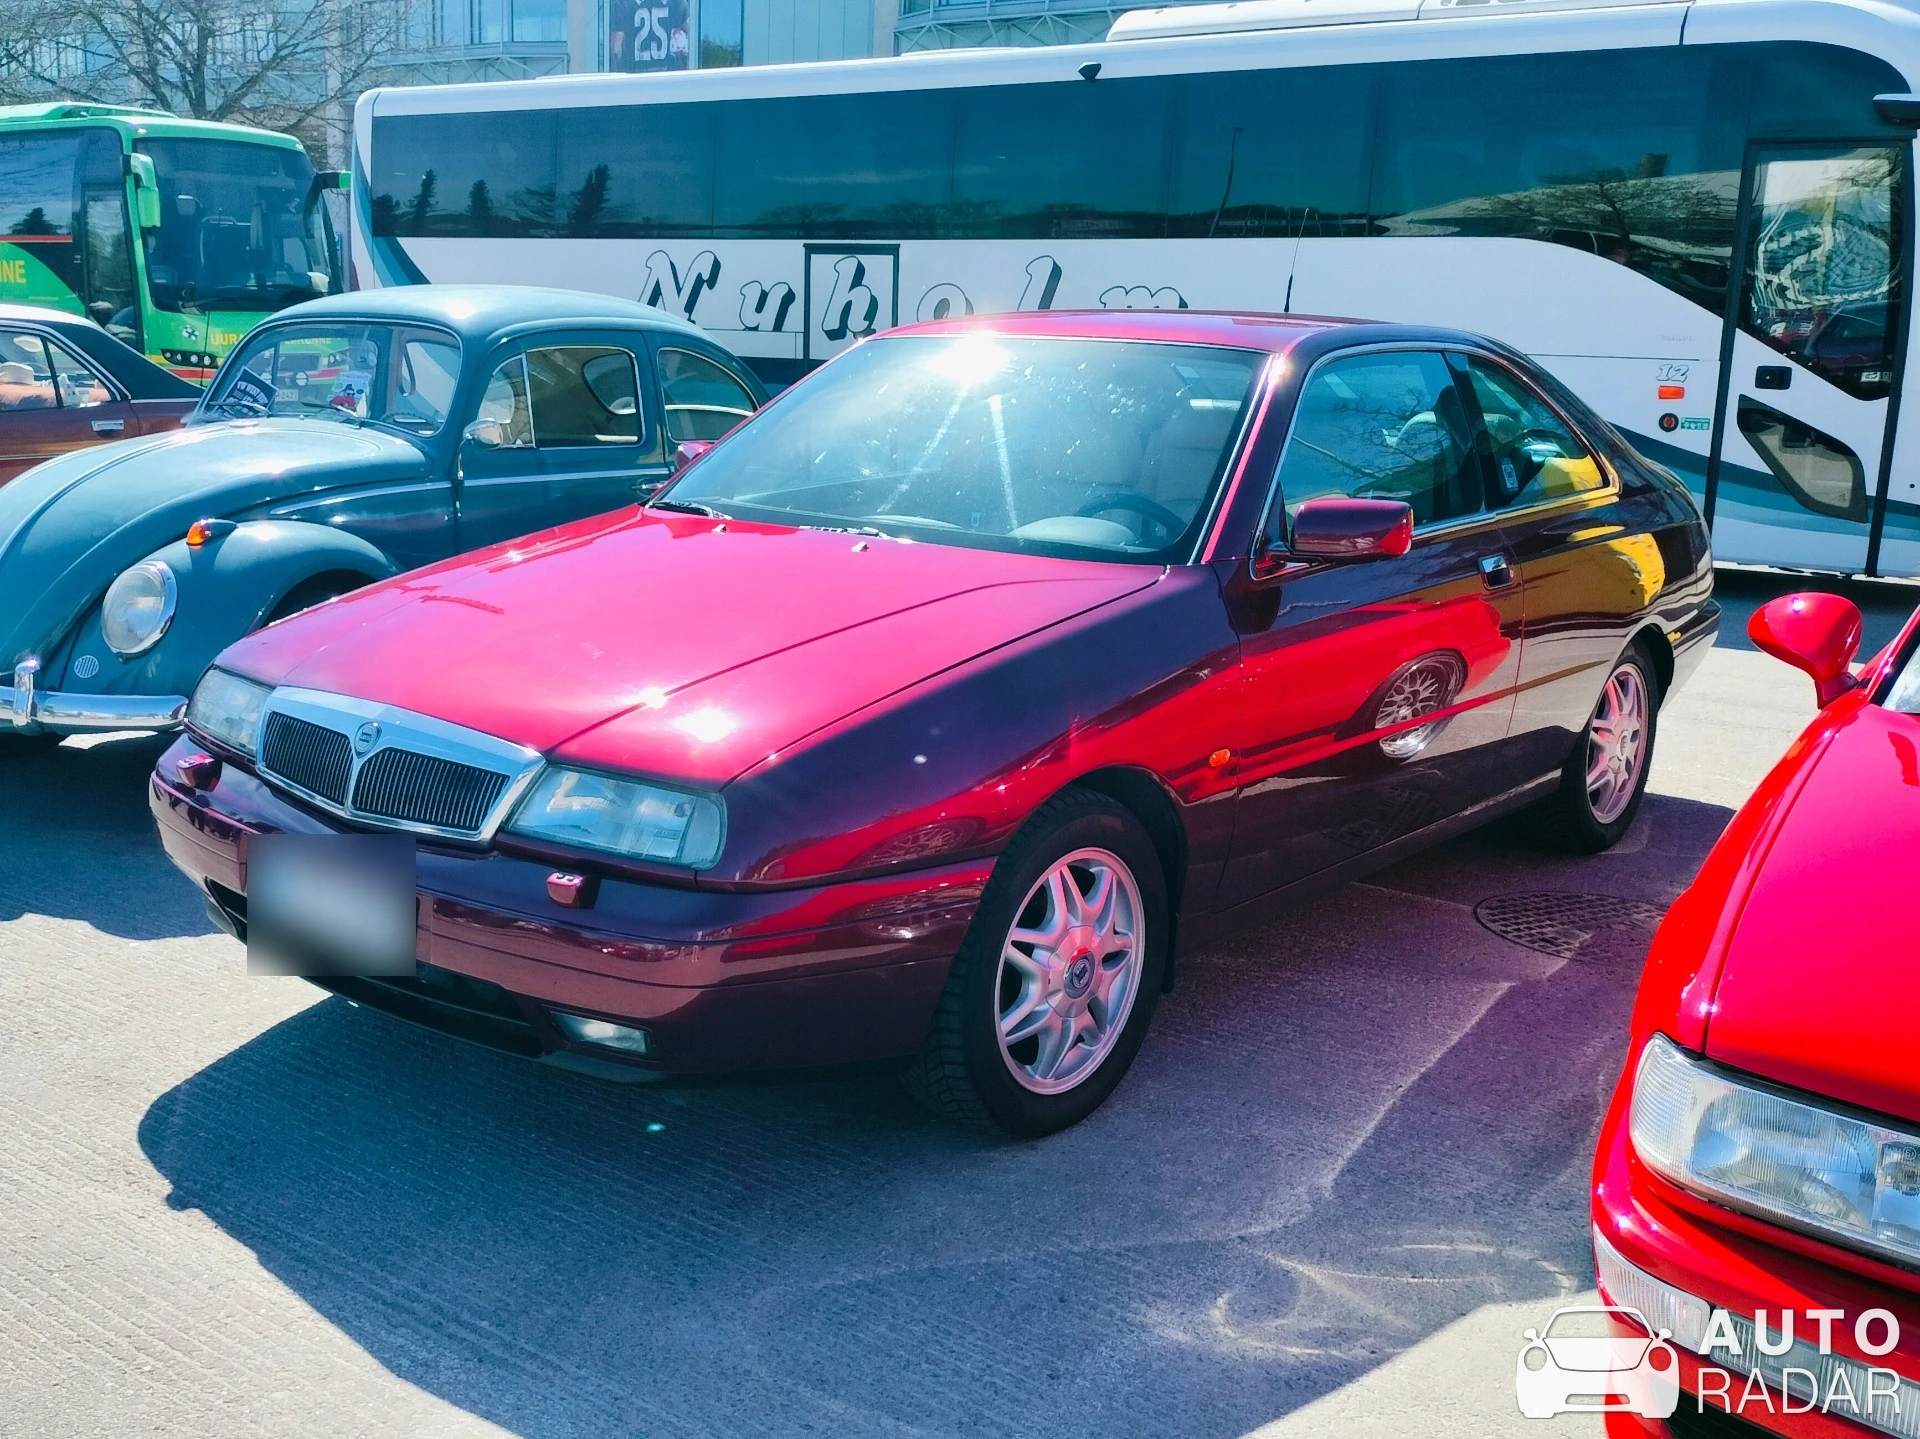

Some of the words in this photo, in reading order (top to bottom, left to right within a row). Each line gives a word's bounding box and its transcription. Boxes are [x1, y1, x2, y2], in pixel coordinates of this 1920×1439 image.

[634, 7, 669, 61] 25
[0, 259, 26, 283] NE
[1656, 364, 1689, 383] 12
